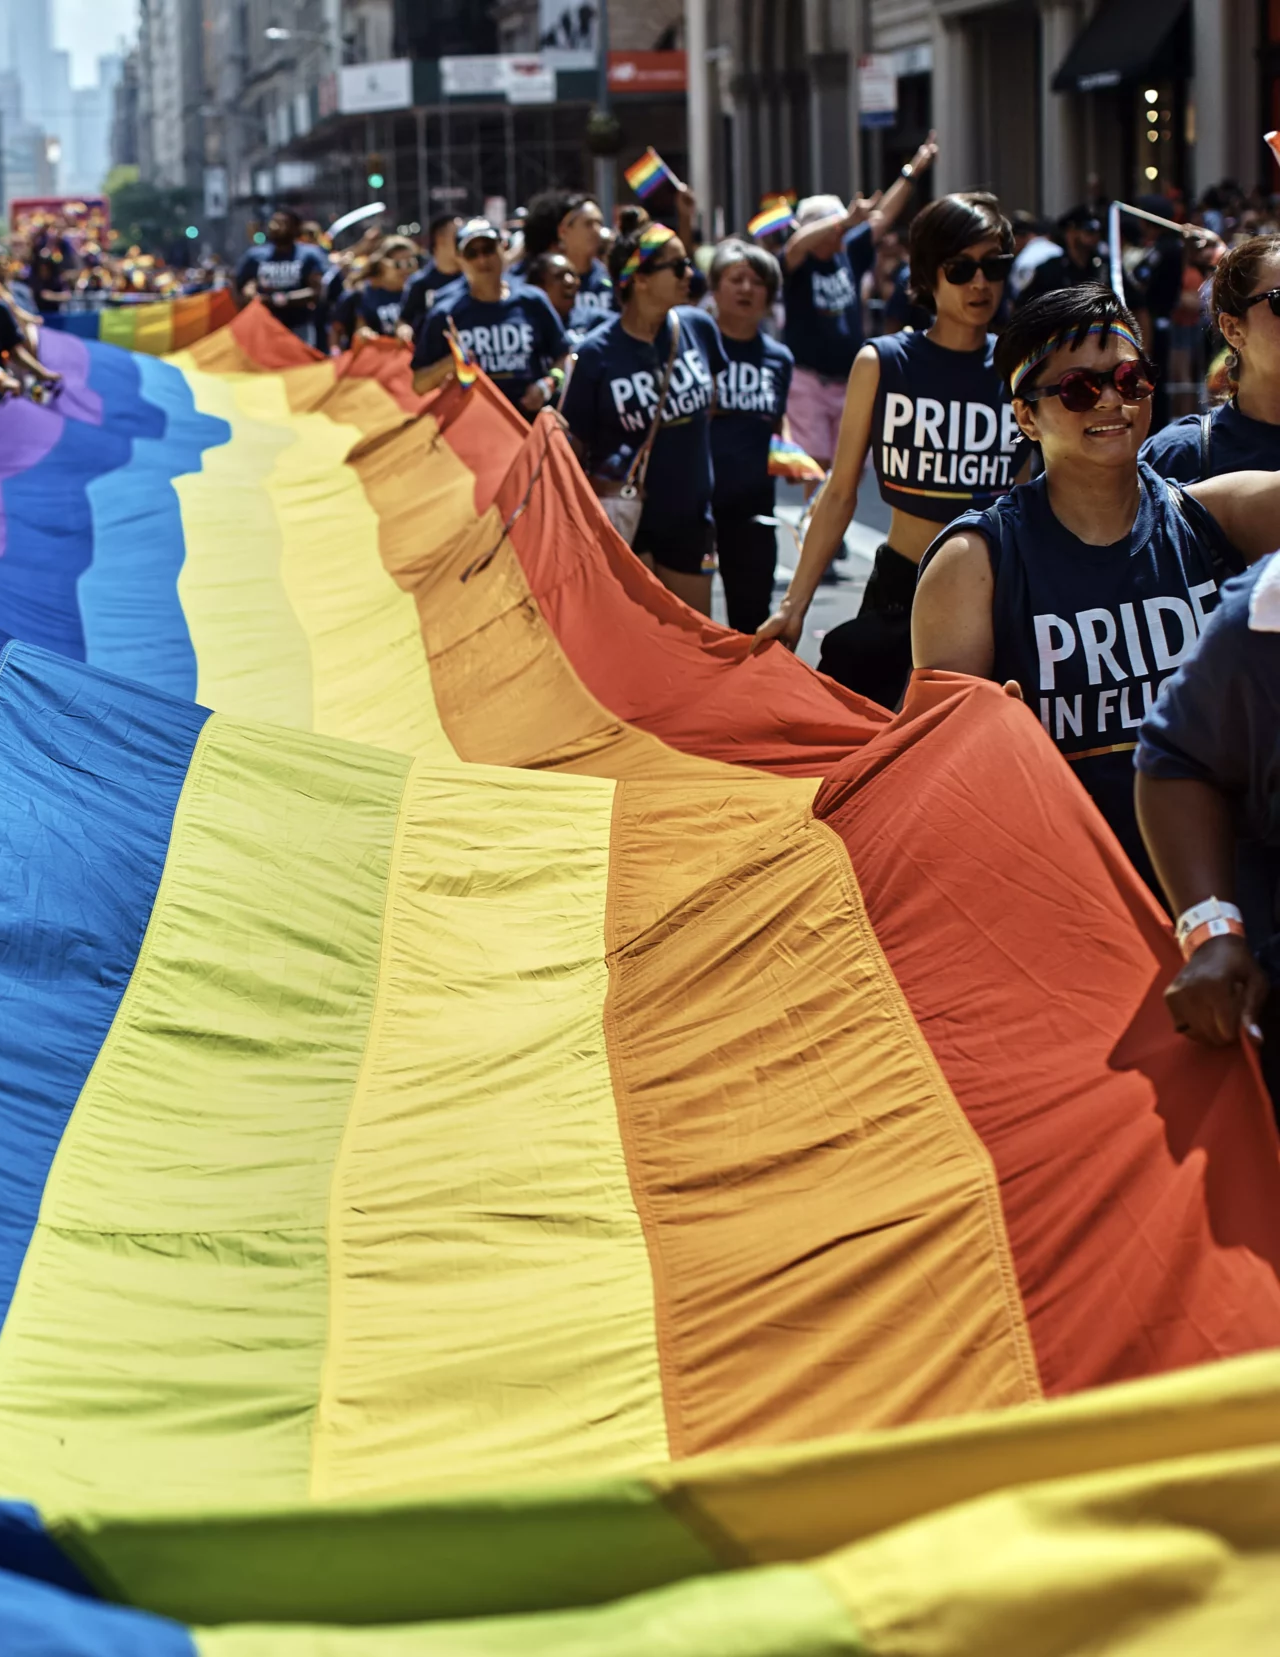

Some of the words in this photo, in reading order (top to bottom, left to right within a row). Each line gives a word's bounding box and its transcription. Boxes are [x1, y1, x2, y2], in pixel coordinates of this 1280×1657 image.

[458, 323, 534, 355] PRIDE
[716, 361, 775, 393] IDE
[620, 409, 645, 432] IN
[883, 392, 1020, 453] PRIDE
[882, 445, 910, 480] IN
[1040, 694, 1083, 740] IN
[1097, 676, 1171, 733] FLI
